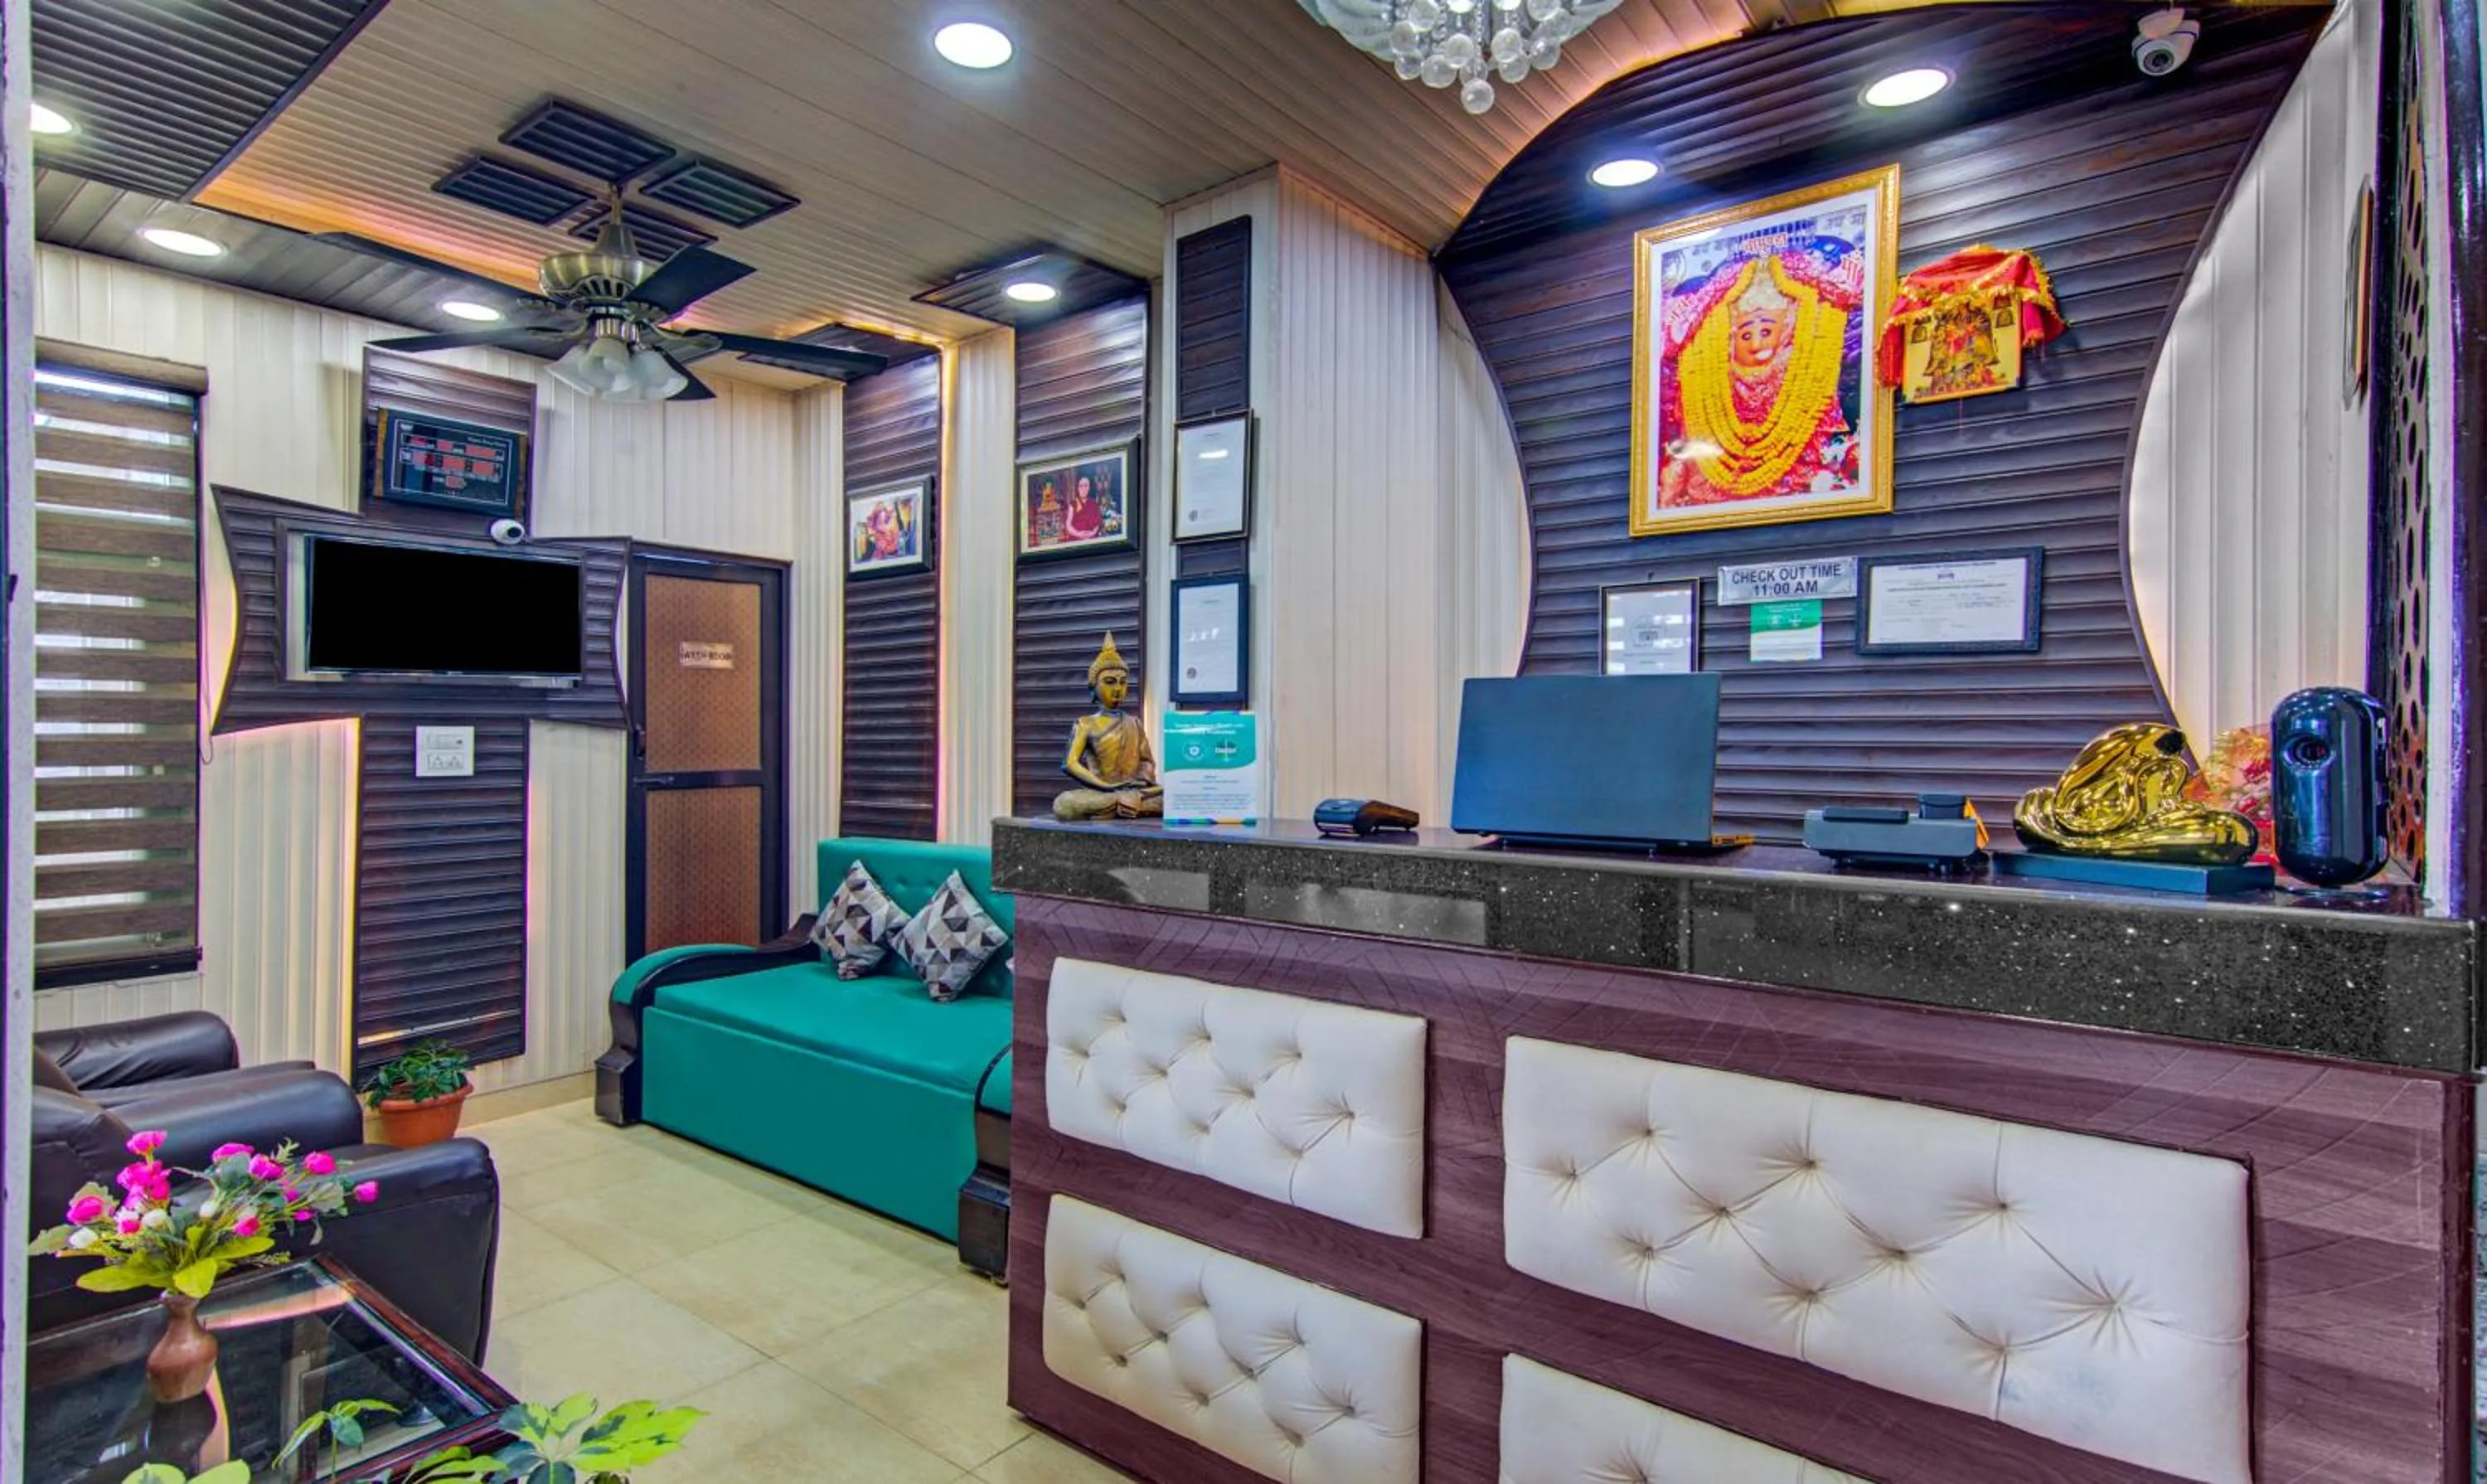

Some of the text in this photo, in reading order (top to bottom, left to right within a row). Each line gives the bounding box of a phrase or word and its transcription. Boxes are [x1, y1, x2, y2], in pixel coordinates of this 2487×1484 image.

[1732, 563, 1842, 584] CHECK OUT TIME
[1794, 580, 1818, 594] AM
